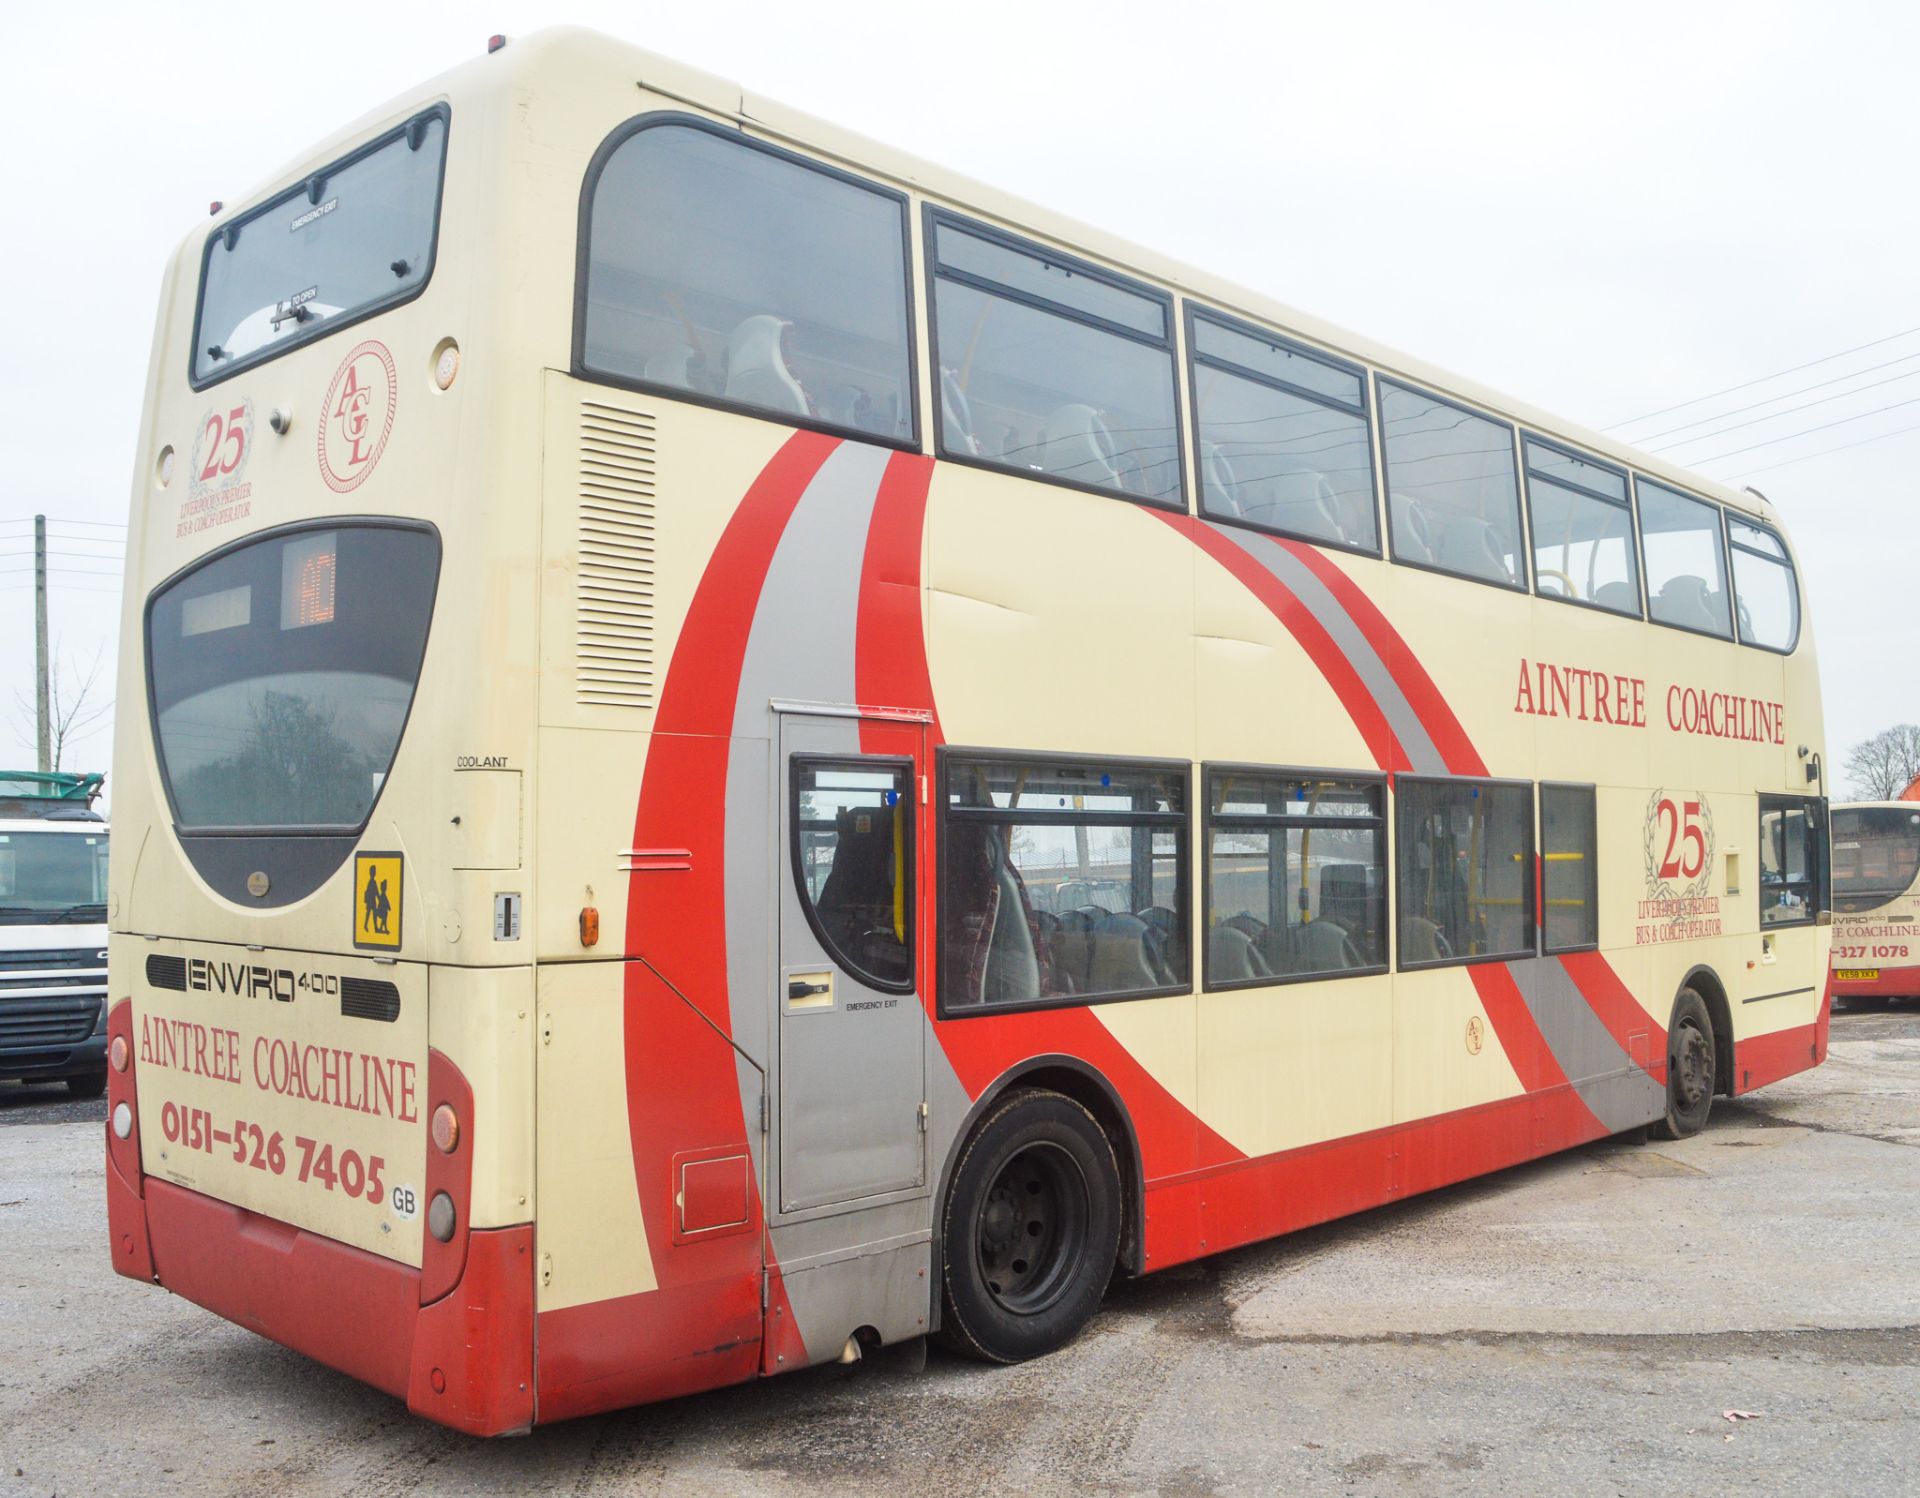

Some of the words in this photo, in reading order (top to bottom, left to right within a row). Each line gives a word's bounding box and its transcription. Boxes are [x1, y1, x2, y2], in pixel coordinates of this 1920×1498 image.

[292, 206, 323, 230] EMERGENCY
[324, 199, 337, 213] EXIT
[293, 295, 300, 306] TO
[300, 288, 317, 303] OPEN
[200, 405, 246, 482] 25
[220, 482, 252, 505] PREMIER
[176, 521, 188, 538] BUS
[188, 520, 194, 534] &
[194, 512, 215, 532] COACH
[215, 501, 252, 525] OPERATOR
[1514, 658, 1646, 728] AINTREE
[1666, 685, 1785, 745] COACHLINE
[457, 757, 508, 768] COOLANT
[1657, 798, 1705, 879] 25
[1689, 896, 1720, 915] PREMIER
[1635, 925, 1650, 944] BUS
[1651, 924, 1657, 942] &
[1659, 921, 1684, 942] COACH
[1685, 918, 1722, 939] OPERATOR
[1846, 925, 1920, 938] COACHLINE
[1871, 945, 1909, 958] 1078
[188, 958, 296, 1003] ENVIRO
[298, 972, 338, 995] 400
[846, 1002, 882, 1011] EMERGENCY
[884, 1000, 898, 1008] EXIT
[140, 1014, 241, 1084] AINTREE
[253, 1036, 418, 1124] COACHLINE
[161, 1100, 286, 1175] 0151-526
[295, 1135, 385, 1205] 7405
[393, 1186, 415, 1214] GB
